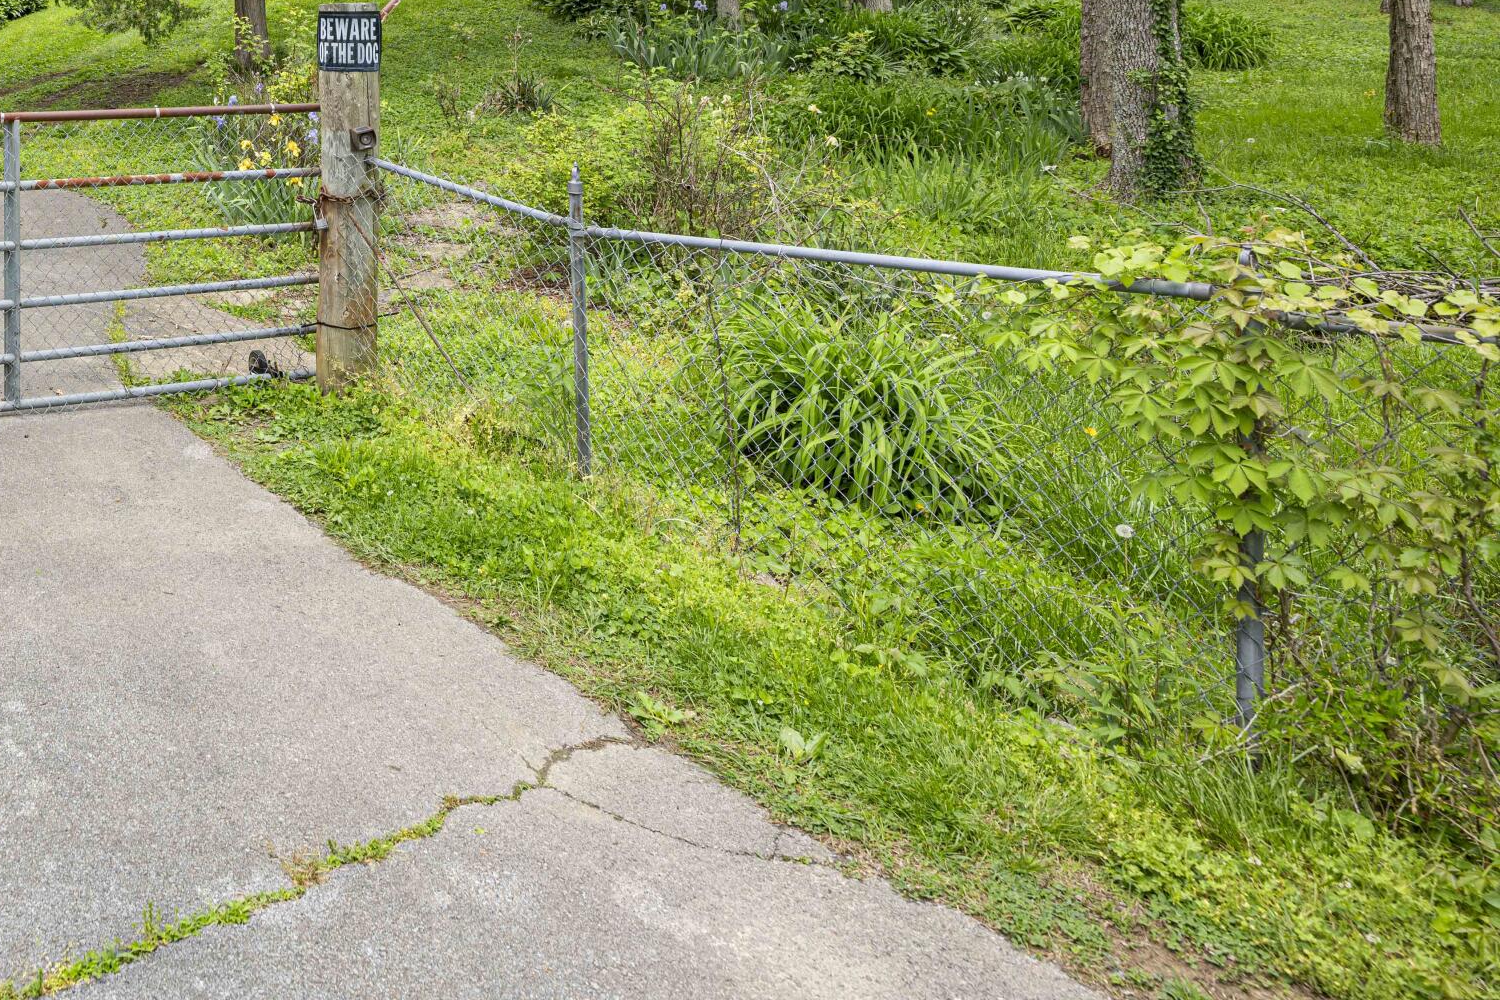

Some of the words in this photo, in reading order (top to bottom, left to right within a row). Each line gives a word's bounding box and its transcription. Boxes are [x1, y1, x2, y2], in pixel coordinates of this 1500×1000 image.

[320, 17, 377, 41] BEWARE
[319, 41, 330, 63] OF
[330, 42, 355, 64] THE
[357, 41, 379, 64] DOG
